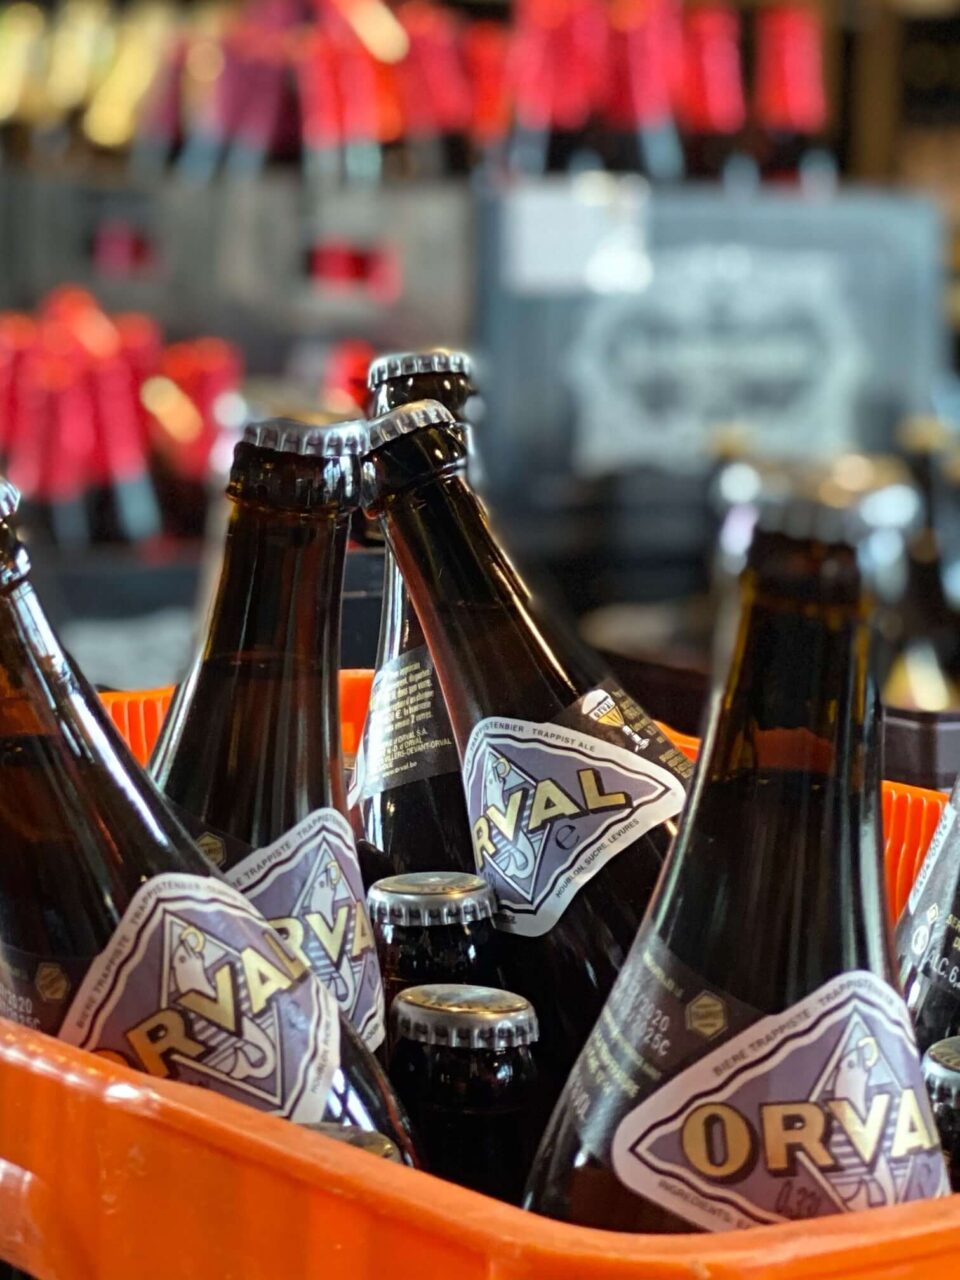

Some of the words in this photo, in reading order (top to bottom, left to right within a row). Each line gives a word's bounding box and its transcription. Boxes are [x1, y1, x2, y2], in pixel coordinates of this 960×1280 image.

[531, 727, 576, 746] TRAPPIST
[577, 740, 596, 753] ALE
[245, 840, 292, 880] TRAPPISTE
[748, 1009, 811, 1052] TRAPPISTE
